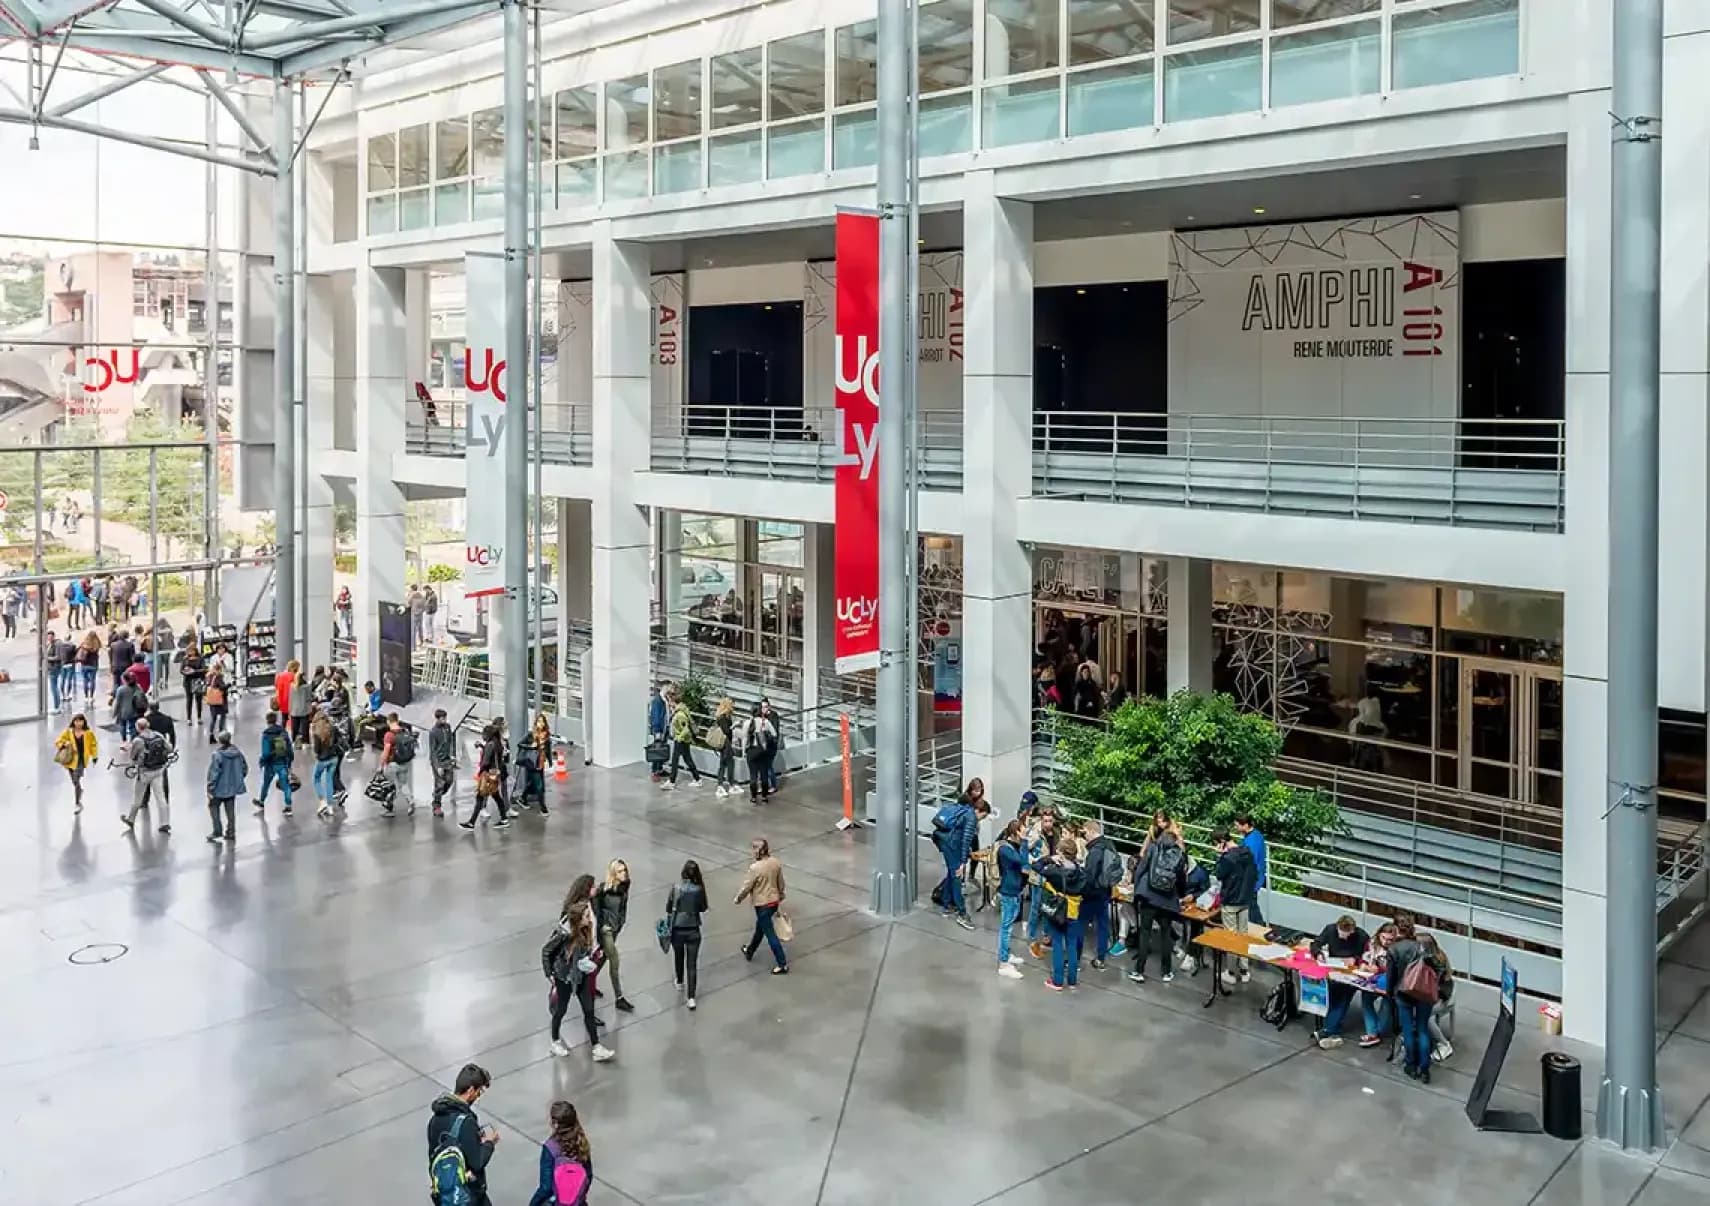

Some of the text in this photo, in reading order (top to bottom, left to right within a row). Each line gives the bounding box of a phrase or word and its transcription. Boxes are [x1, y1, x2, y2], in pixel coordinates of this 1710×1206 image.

[1242, 267, 1394, 331] AMPHI
[1402, 261, 1443, 356] A 101
[659, 304, 676, 365] A 103
[1294, 339, 1393, 358] RENE MOUTERDE
[466, 403, 506, 456] Ly
[835, 408, 880, 481] Ly
[836, 595, 878, 624] UCLy
